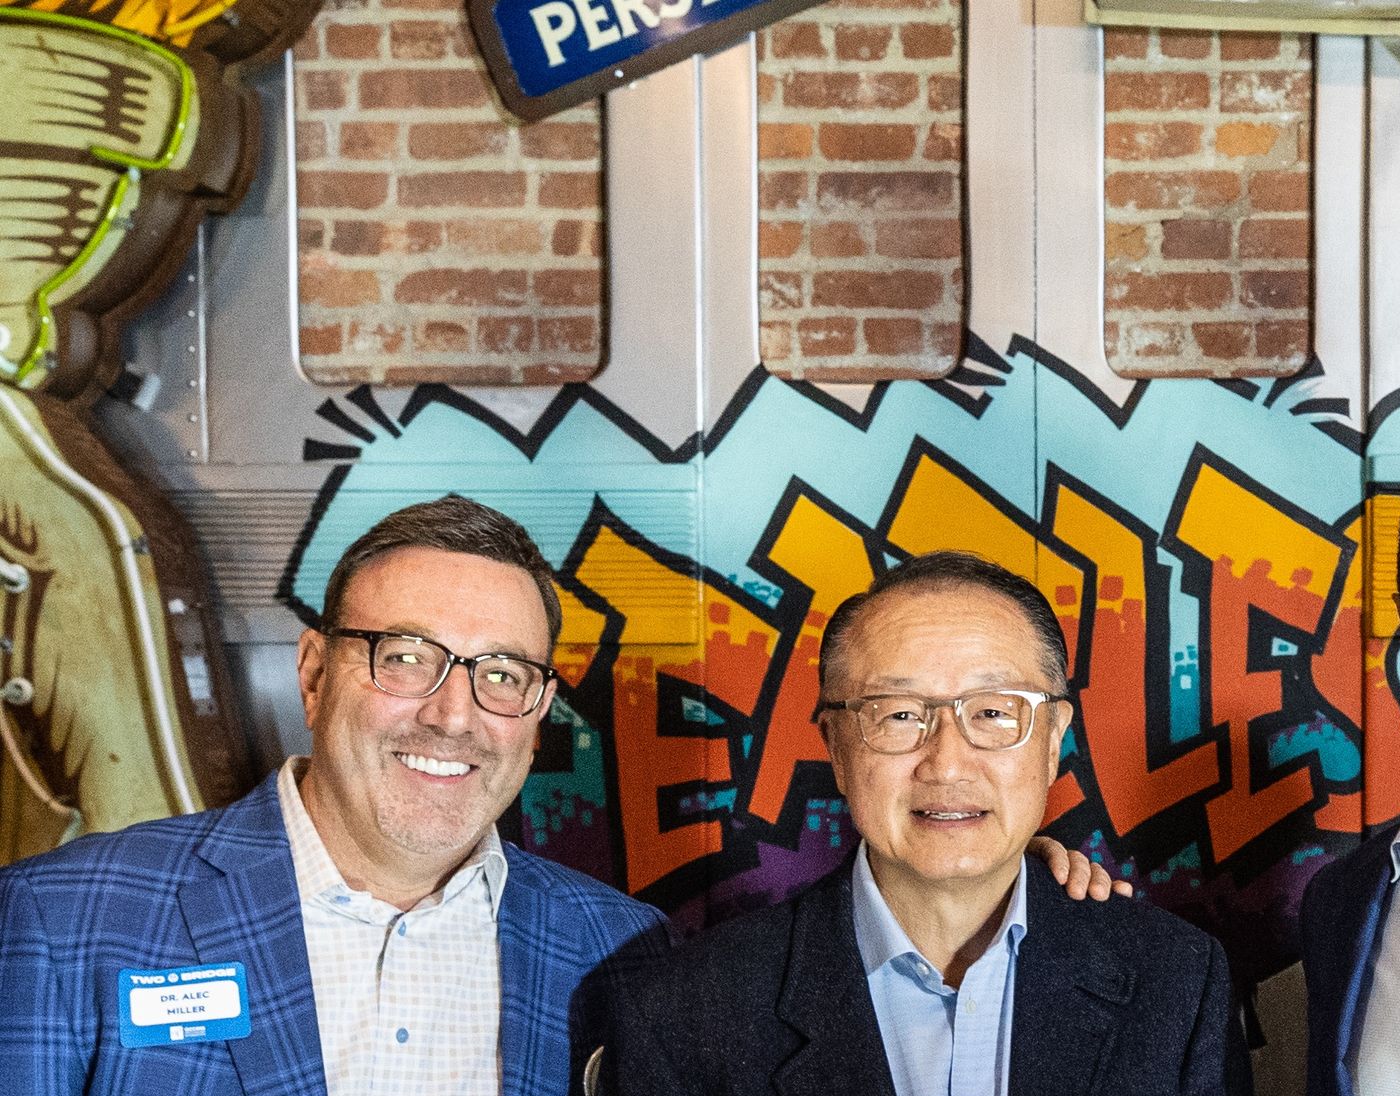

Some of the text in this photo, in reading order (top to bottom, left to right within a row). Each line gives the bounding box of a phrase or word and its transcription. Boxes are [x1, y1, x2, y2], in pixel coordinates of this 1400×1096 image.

[130, 975, 166, 985] TWO
[160, 991, 209, 1002] DR. ALEC
[167, 1005, 206, 1015] MILLER
